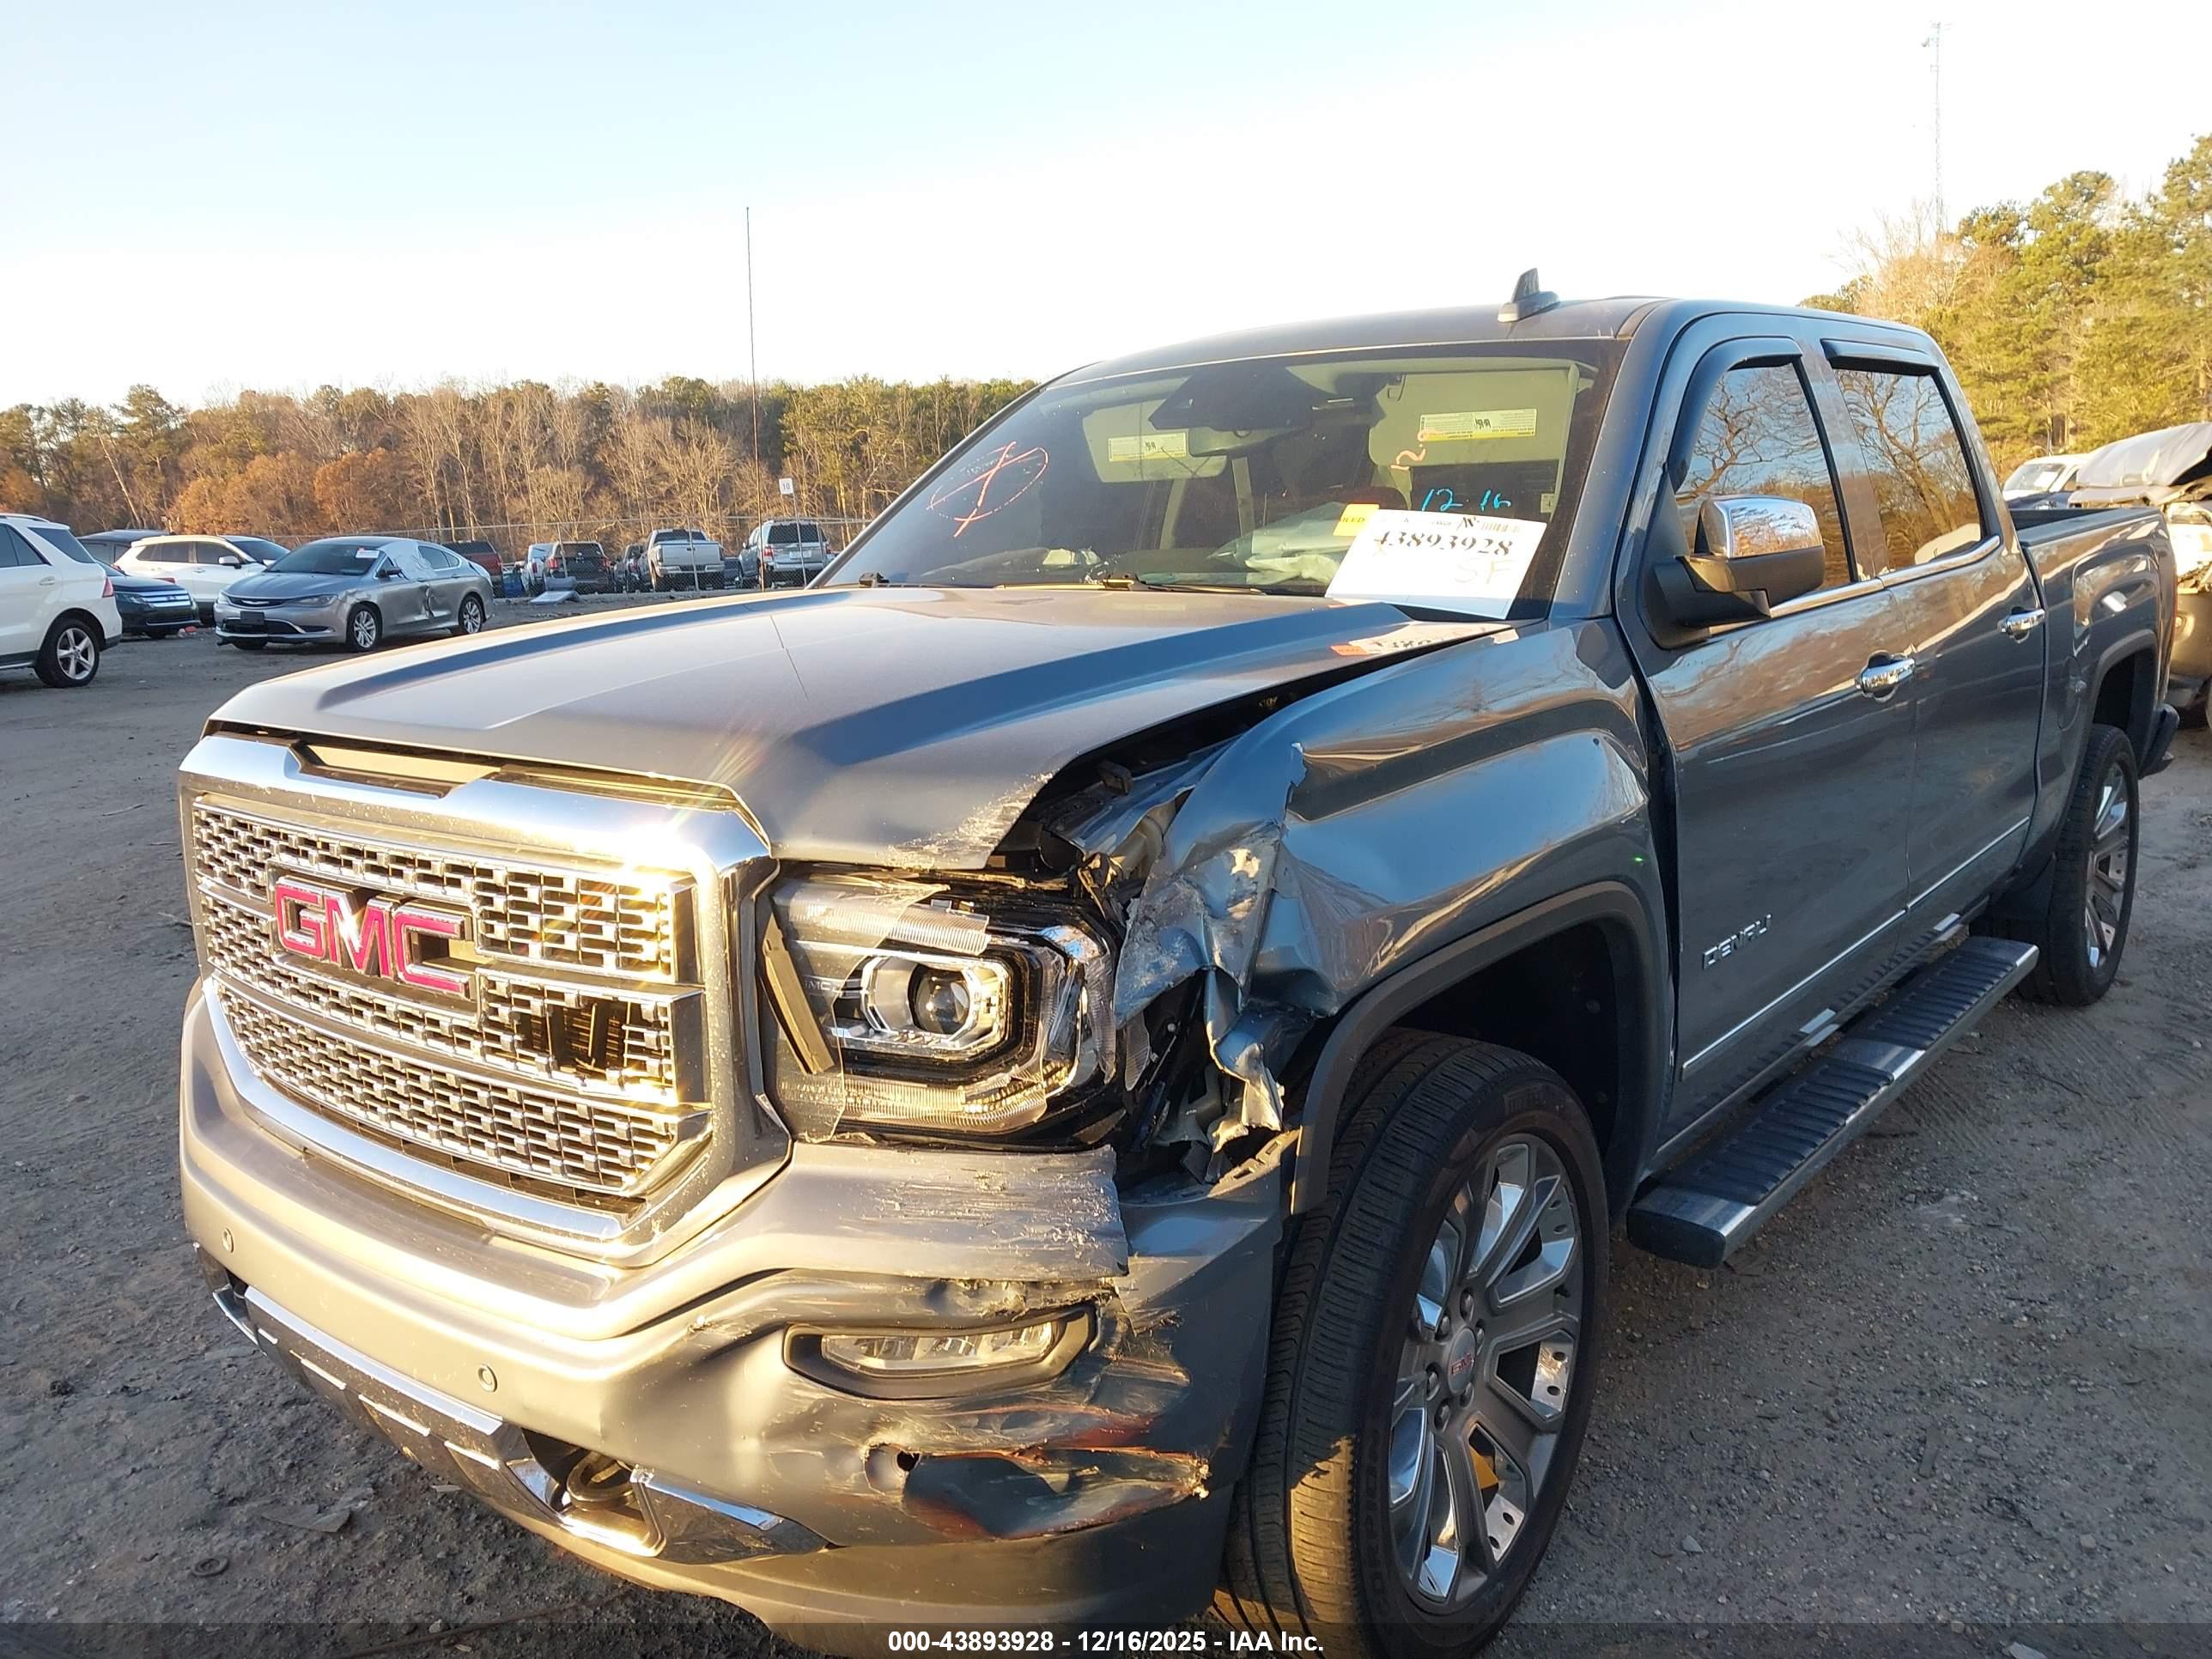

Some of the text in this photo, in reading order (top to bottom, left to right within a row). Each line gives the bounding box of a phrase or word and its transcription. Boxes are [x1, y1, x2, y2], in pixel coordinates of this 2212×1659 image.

[1374, 530, 1514, 556] 43893928
[274, 875, 476, 999] GMC
[1702, 914, 1771, 969] DENALI
